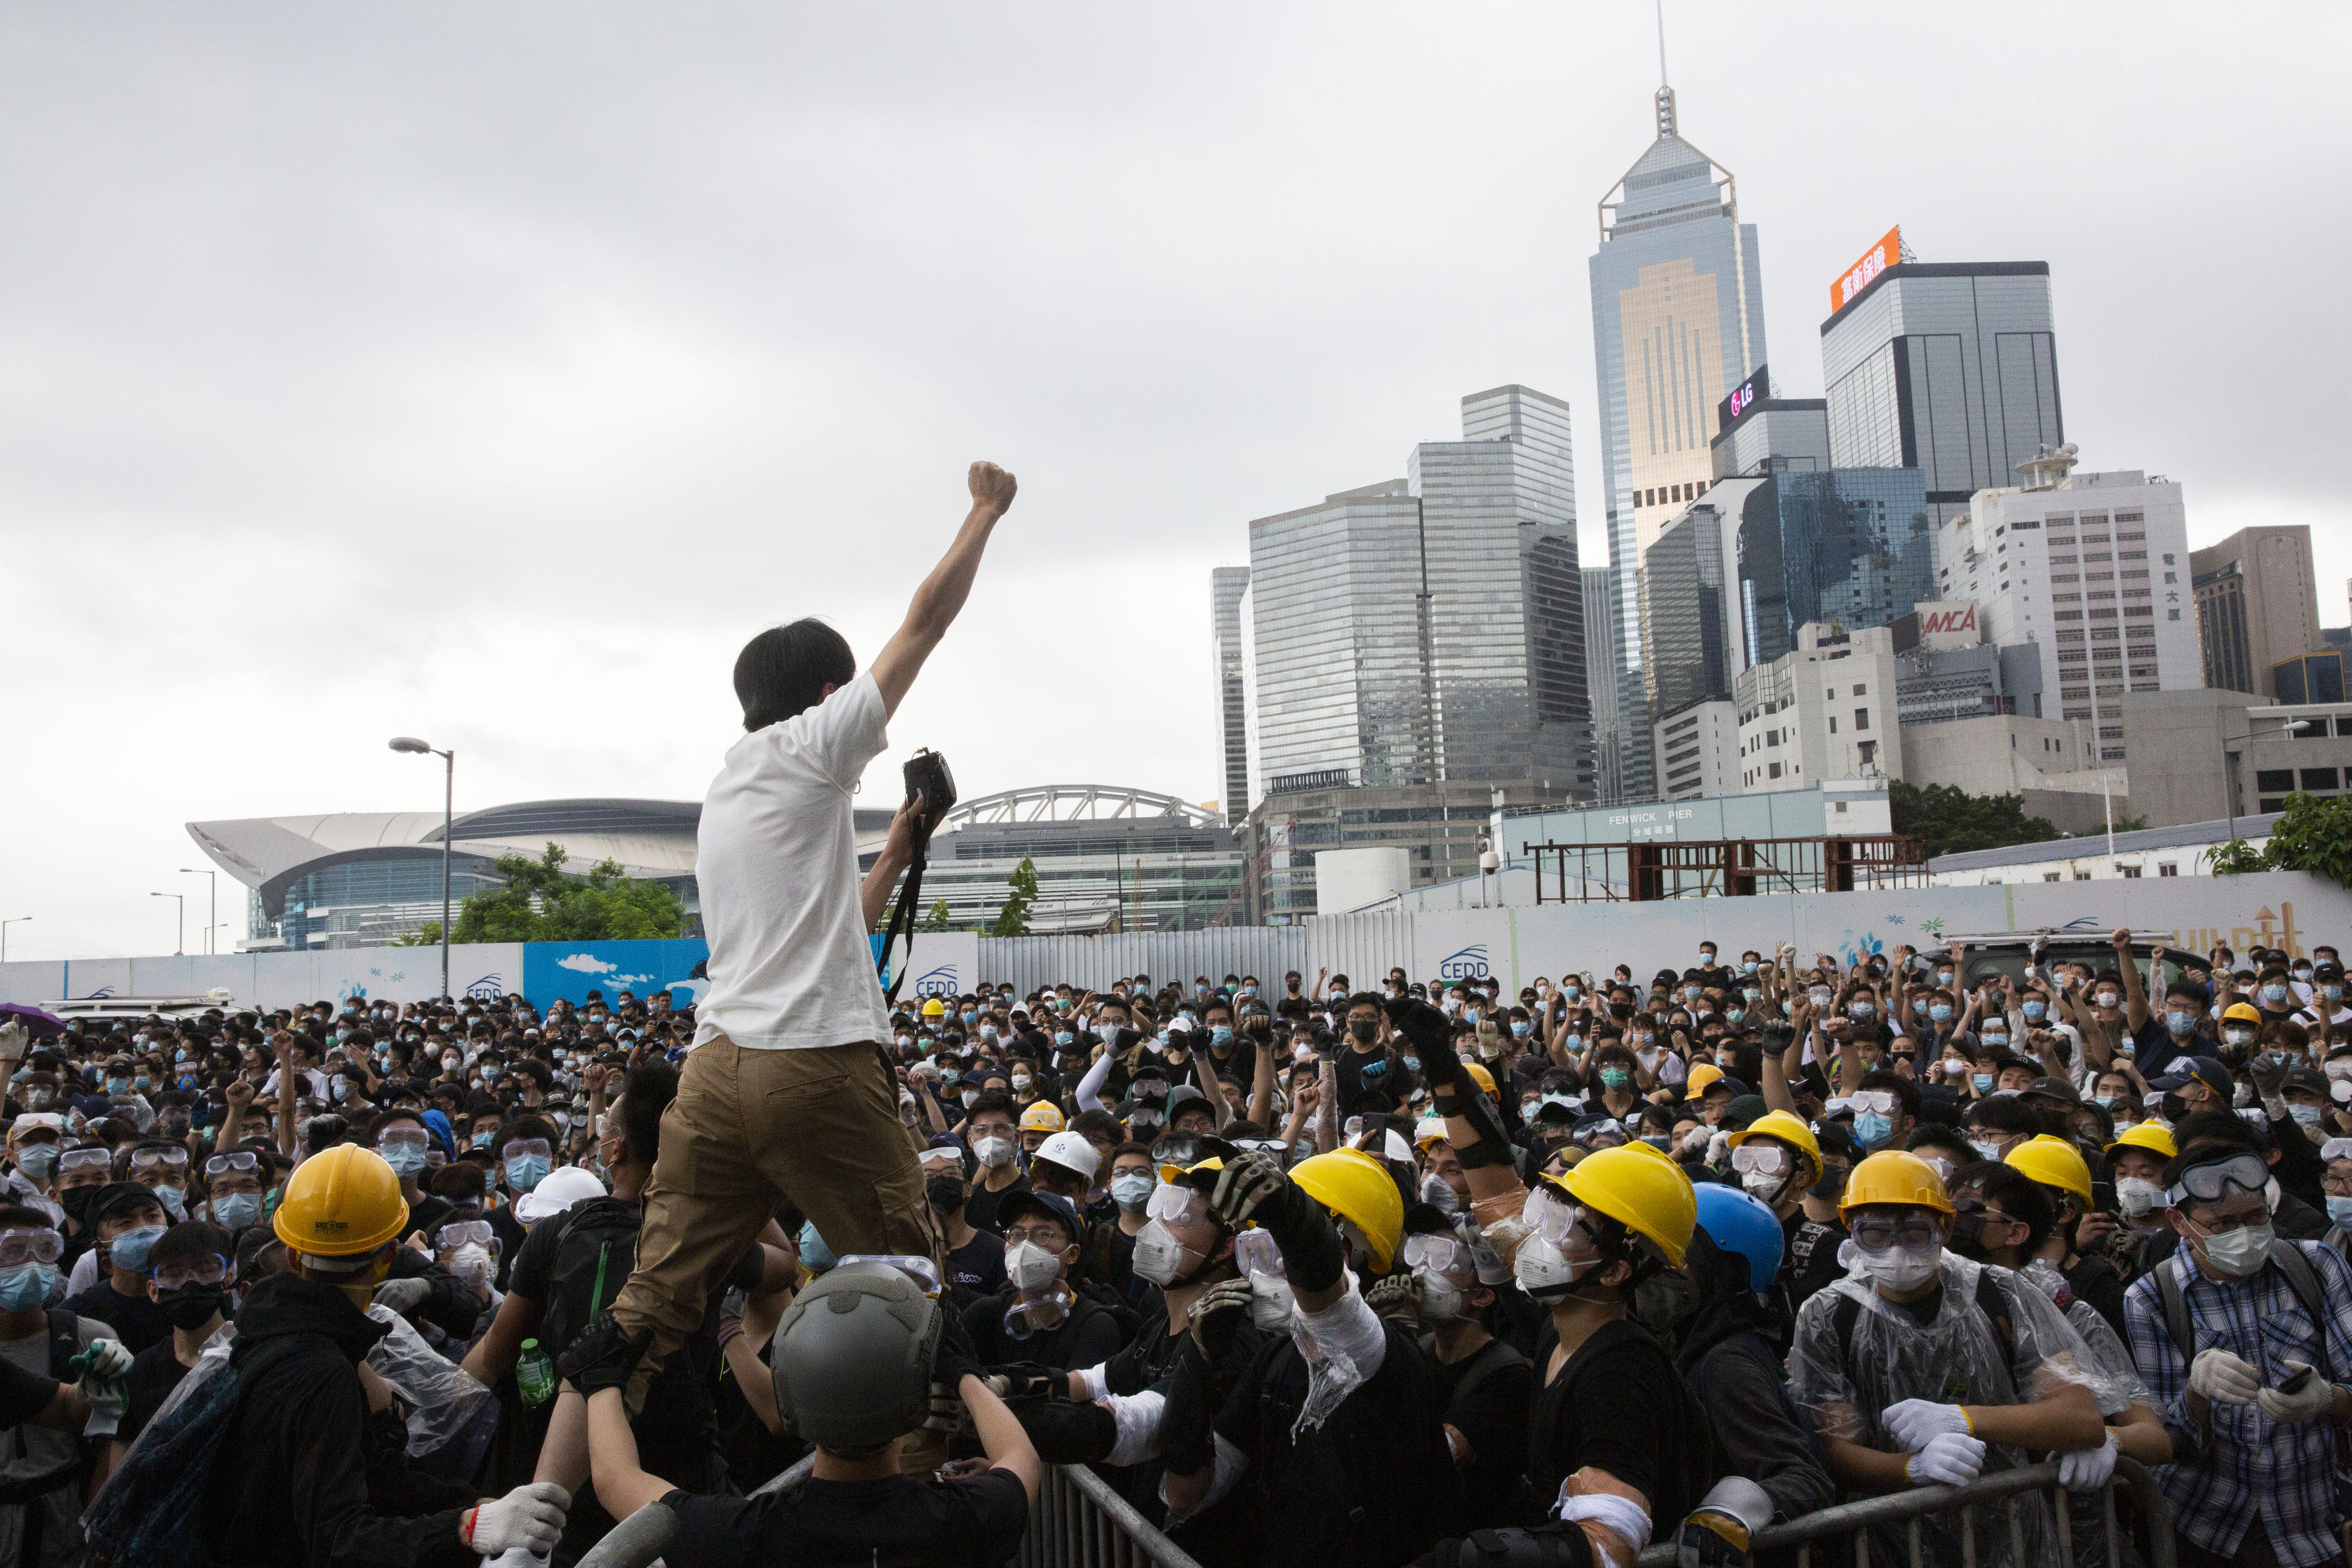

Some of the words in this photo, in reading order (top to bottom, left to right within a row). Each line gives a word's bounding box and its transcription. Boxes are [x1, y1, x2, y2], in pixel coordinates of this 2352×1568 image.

[1841, 245, 1886, 304] 富衛保險
[1741, 383, 1753, 408] LG
[1609, 812, 1656, 825] FENWICK
[1668, 809, 1693, 820] PIER
[1633, 825, 1674, 837] 分域碼頭
[2147, 927, 2257, 954] UILD
[1441, 962, 1489, 979] CEDD
[467, 988, 502, 1002] CEDD
[916, 981, 958, 996] CEDD
[1810, 1120, 1820, 1134] LA
